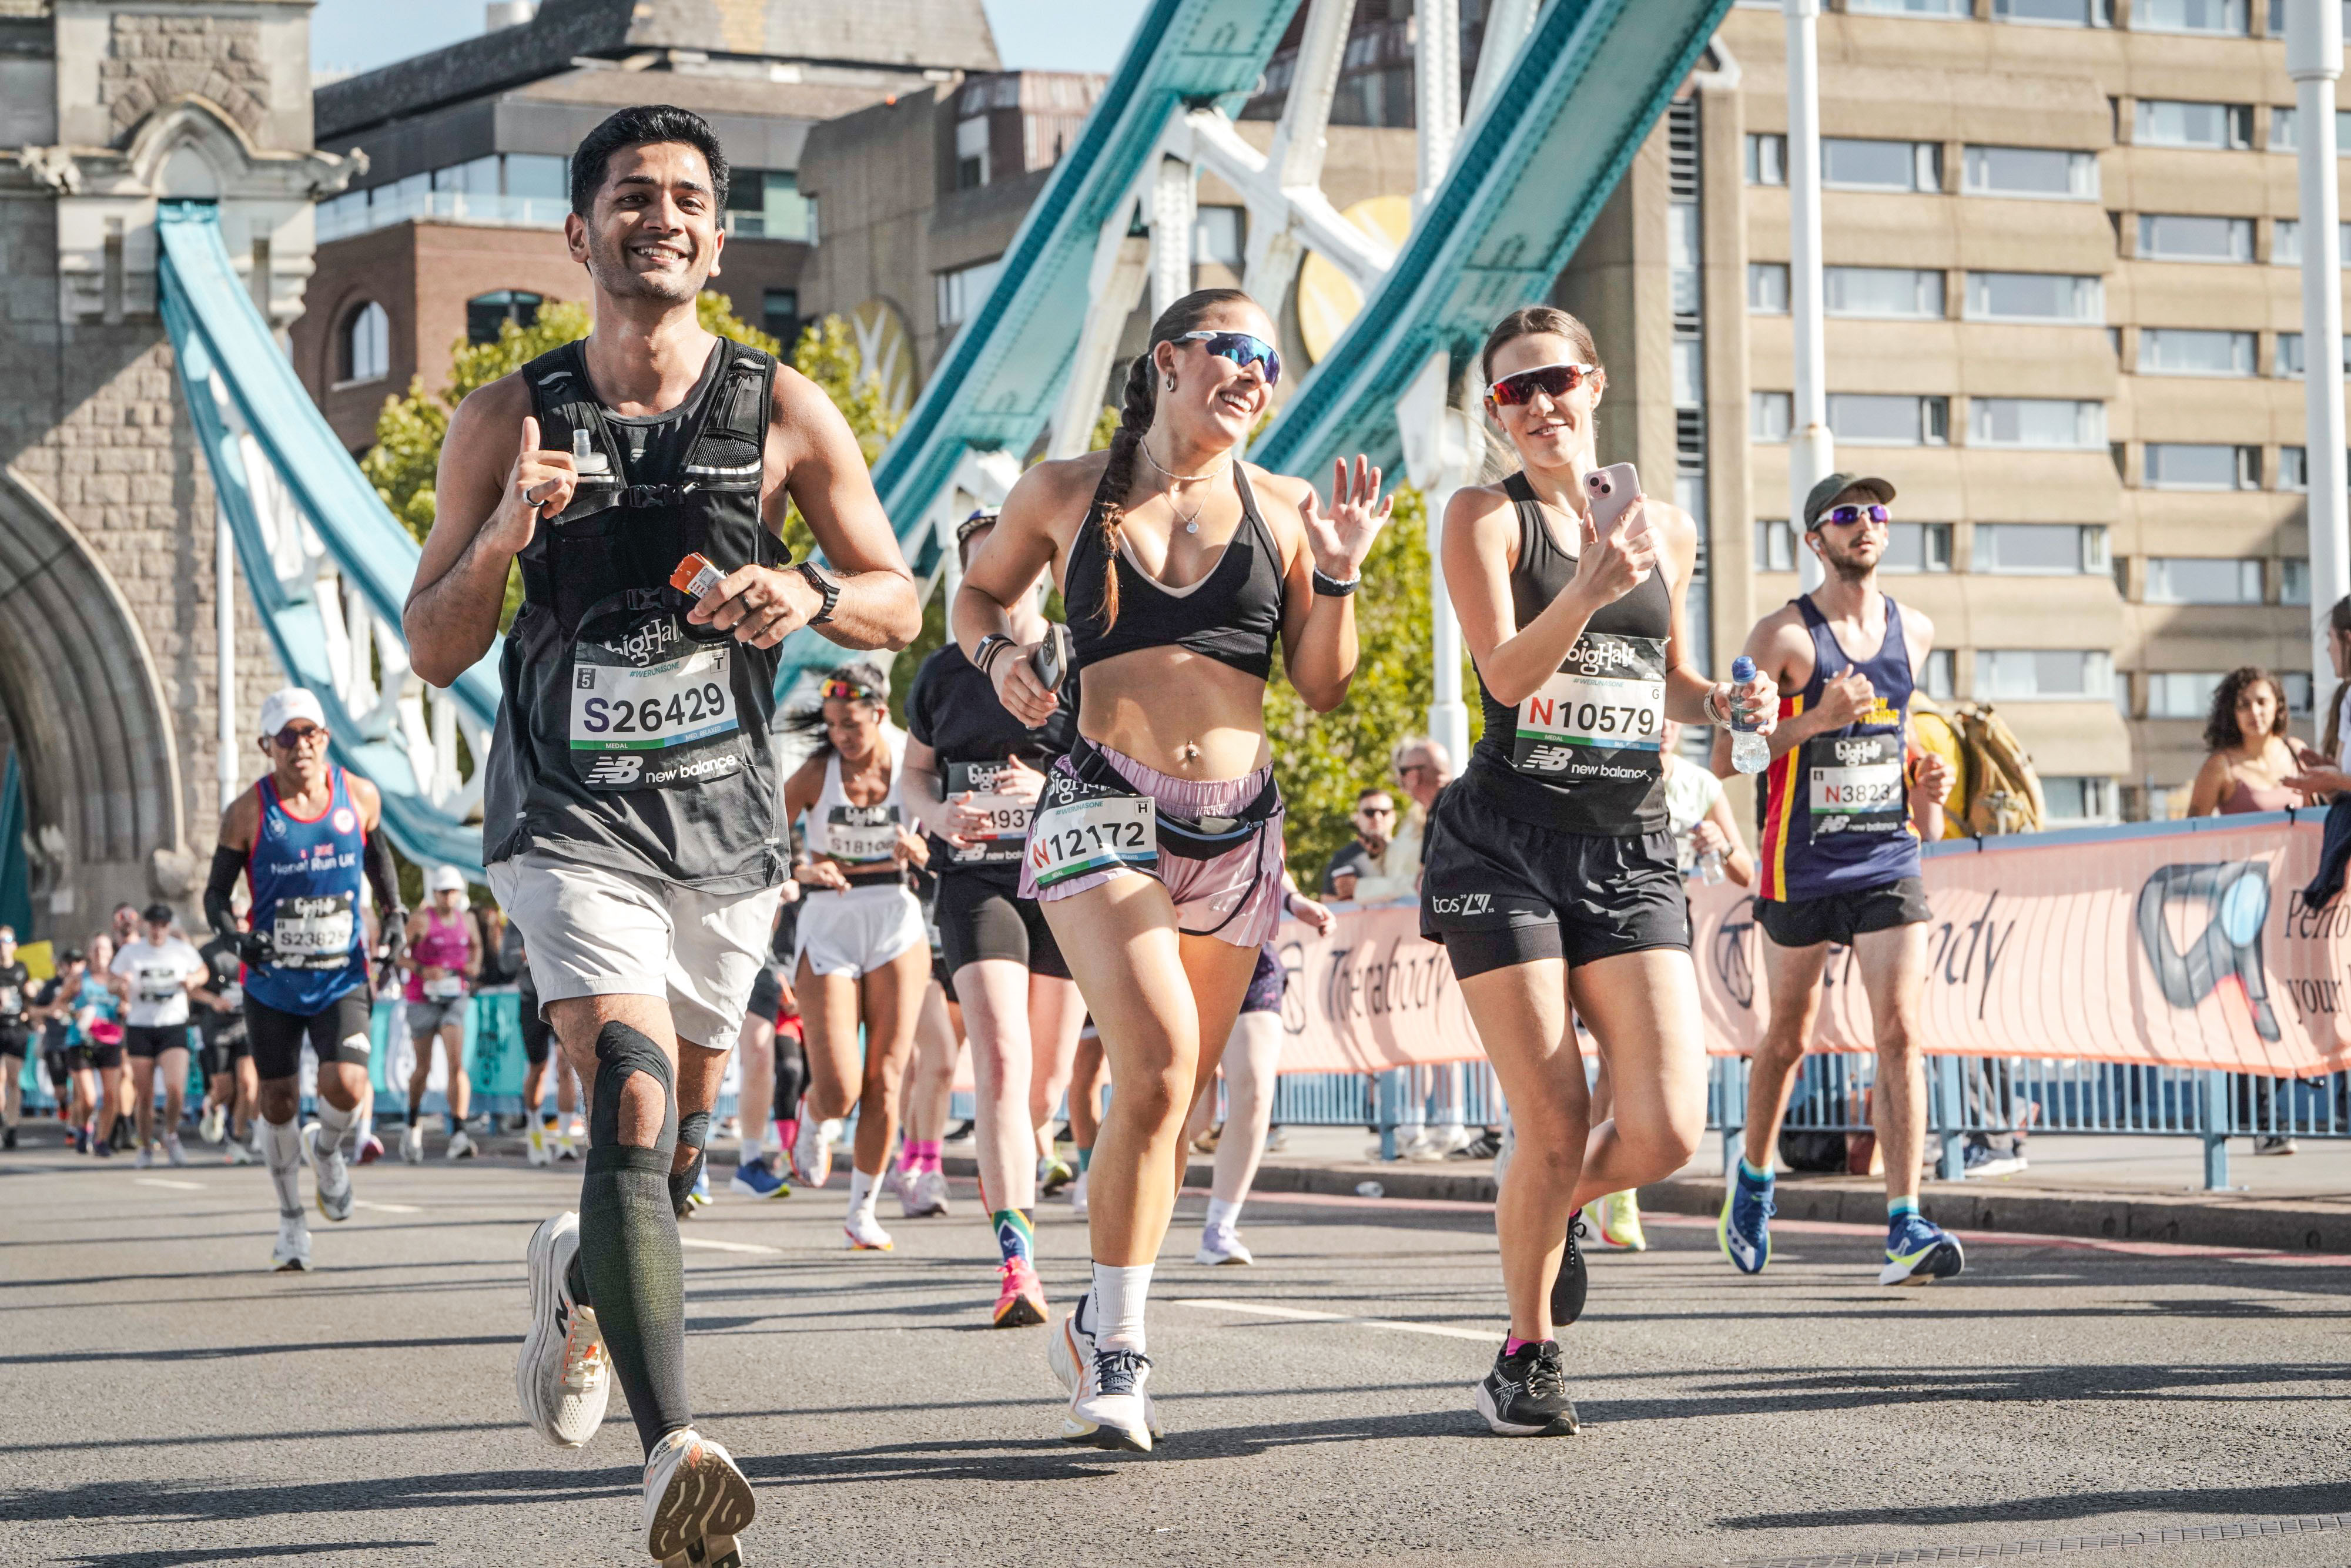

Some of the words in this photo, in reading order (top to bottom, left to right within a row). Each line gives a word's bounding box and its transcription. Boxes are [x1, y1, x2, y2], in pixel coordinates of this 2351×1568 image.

[630, 661, 680, 678] #WERUNASONE
[714, 657, 724, 669] T
[582, 675, 590, 688] 5
[1573, 678, 1625, 688] #WERUNASONE
[1652, 689, 1659, 699] G
[584, 683, 725, 732] S26429
[1529, 697, 1654, 735] N10579
[700, 726, 721, 736] RELAXED
[646, 770, 678, 783] new
[680, 755, 735, 778] balance
[1571, 764, 1599, 775] new
[1600, 765, 1647, 779] balance
[1826, 785, 1891, 803] N3823
[1056, 801, 1104, 815] #WERUNASONE
[1138, 803, 1148, 813] H
[1033, 822, 1145, 869] N12172
[311, 857, 337, 872] Run
[339, 853, 356, 867] UK
[2286, 979, 2342, 1024] your
